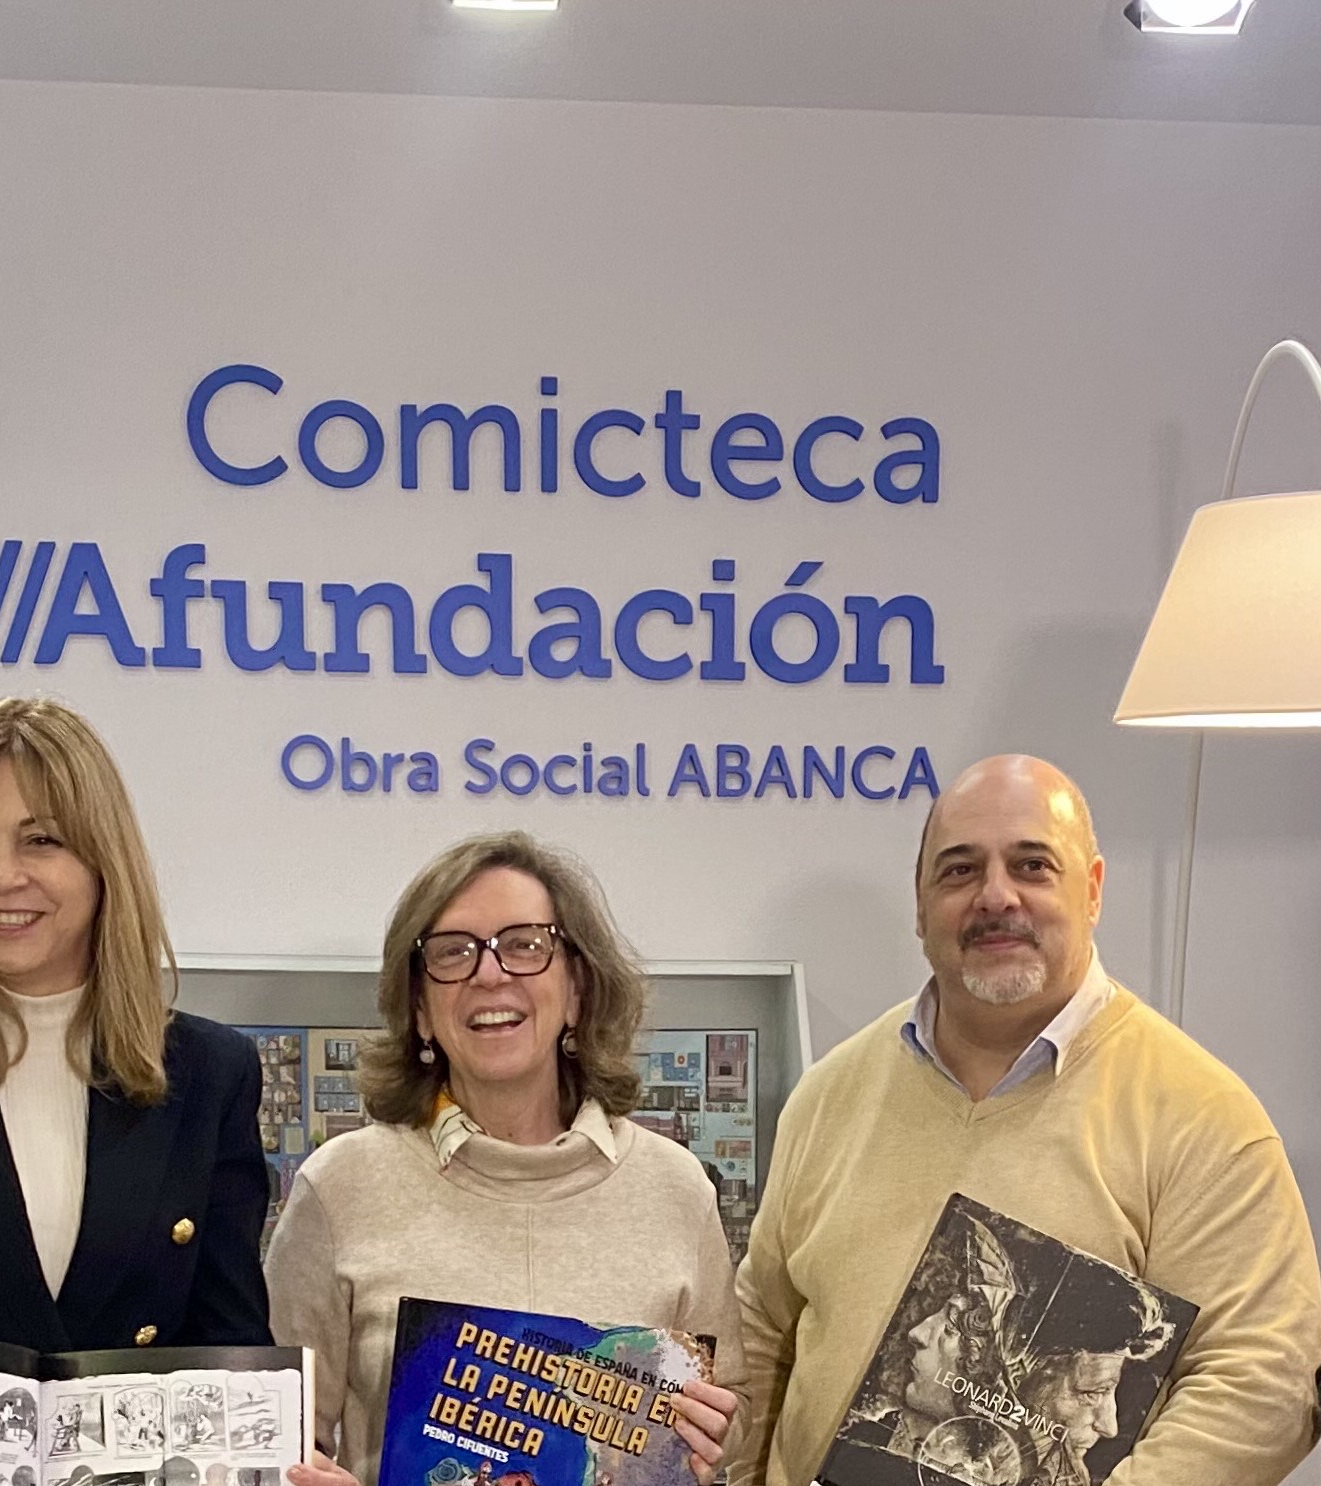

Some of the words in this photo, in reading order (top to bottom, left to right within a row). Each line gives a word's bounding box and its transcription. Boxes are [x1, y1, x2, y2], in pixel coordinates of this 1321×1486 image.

[185, 363, 941, 505] Comicteca
[279, 733, 440, 794] Obra
[463, 737, 647, 797] Social
[667, 742, 940, 800] ABANCA
[455, 1321, 646, 1415] PREHISTORIA
[577, 1347, 592, 1364] DE
[594, 1352, 638, 1380] ESPAÑA
[641, 1371, 658, 1387] EN
[659, 1378, 684, 1394] CÓM
[428, 1391, 545, 1458] IBÉRICA
[442, 1357, 481, 1394] LA
[486, 1373, 649, 1456] PENÍNSULA
[422, 1423, 455, 1445] PEDRO
[457, 1436, 510, 1463] CIFUENTES
